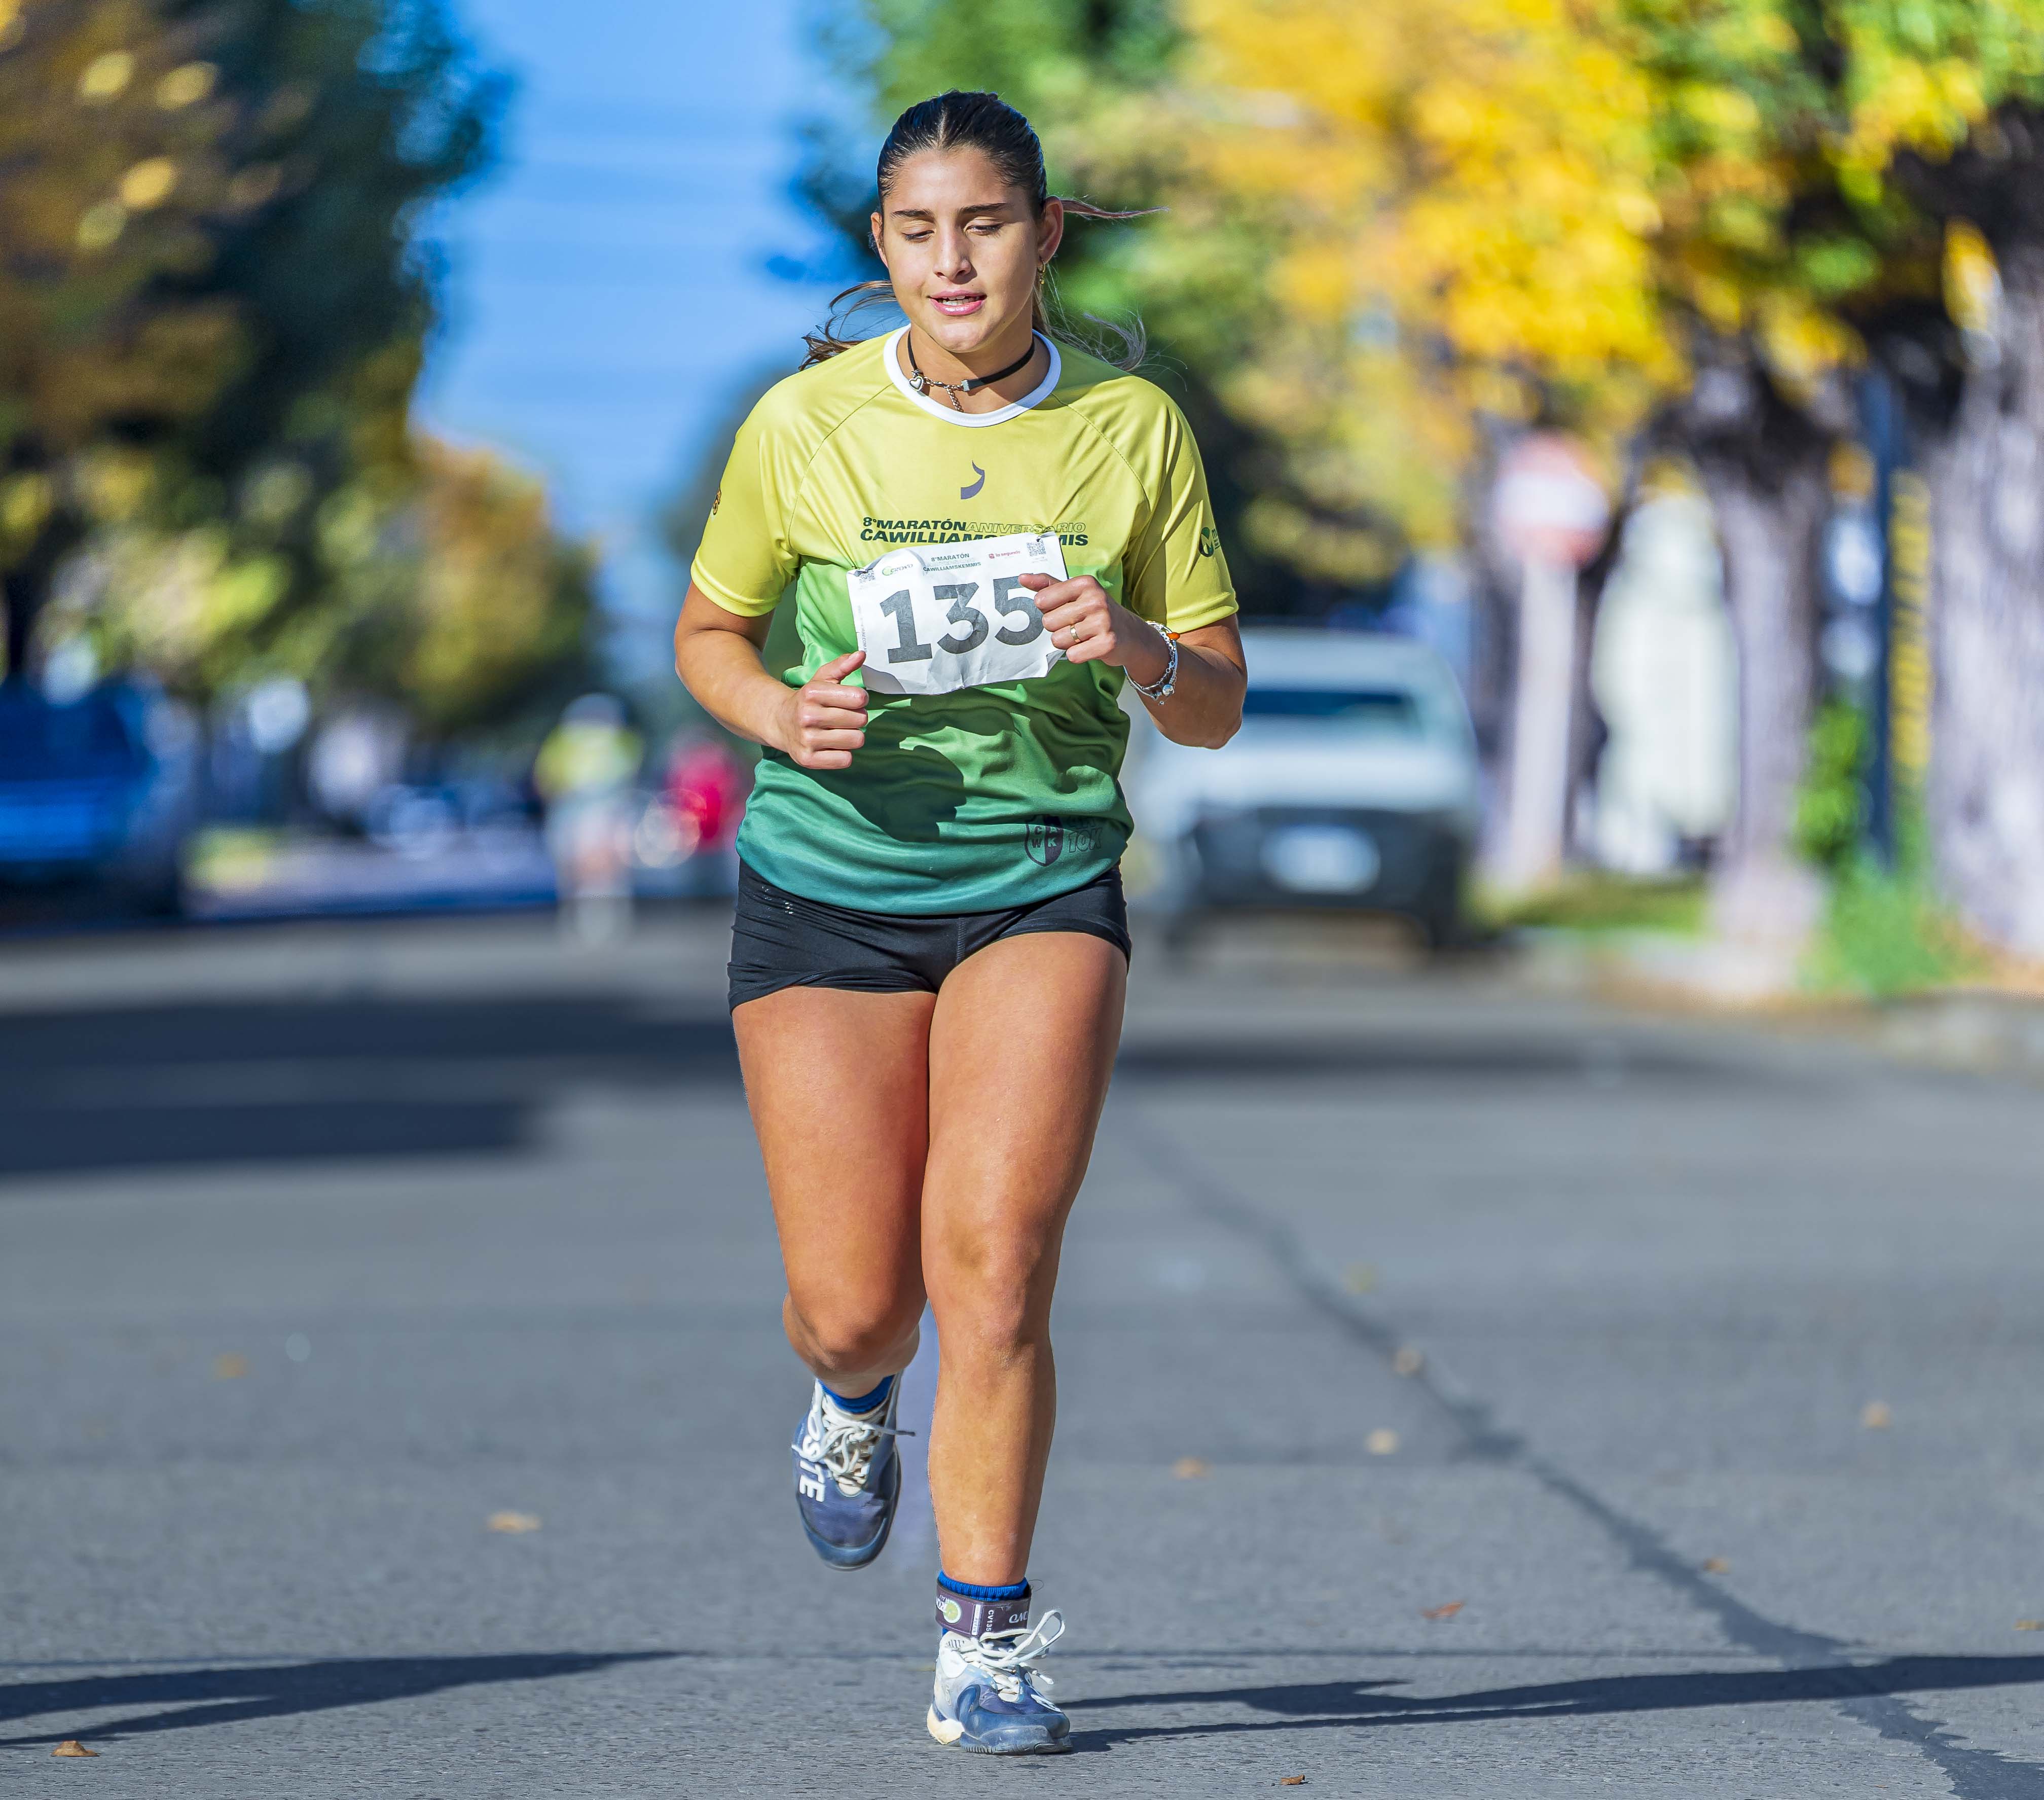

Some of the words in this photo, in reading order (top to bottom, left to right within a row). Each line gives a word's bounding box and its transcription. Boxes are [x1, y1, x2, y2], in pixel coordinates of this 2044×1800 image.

[923, 561, 981, 571] CAWILLIAMSKEMMIS
[880, 573, 1046, 664] 135
[1068, 827, 1103, 853] 10K
[986, 1610, 994, 1632] CV135
